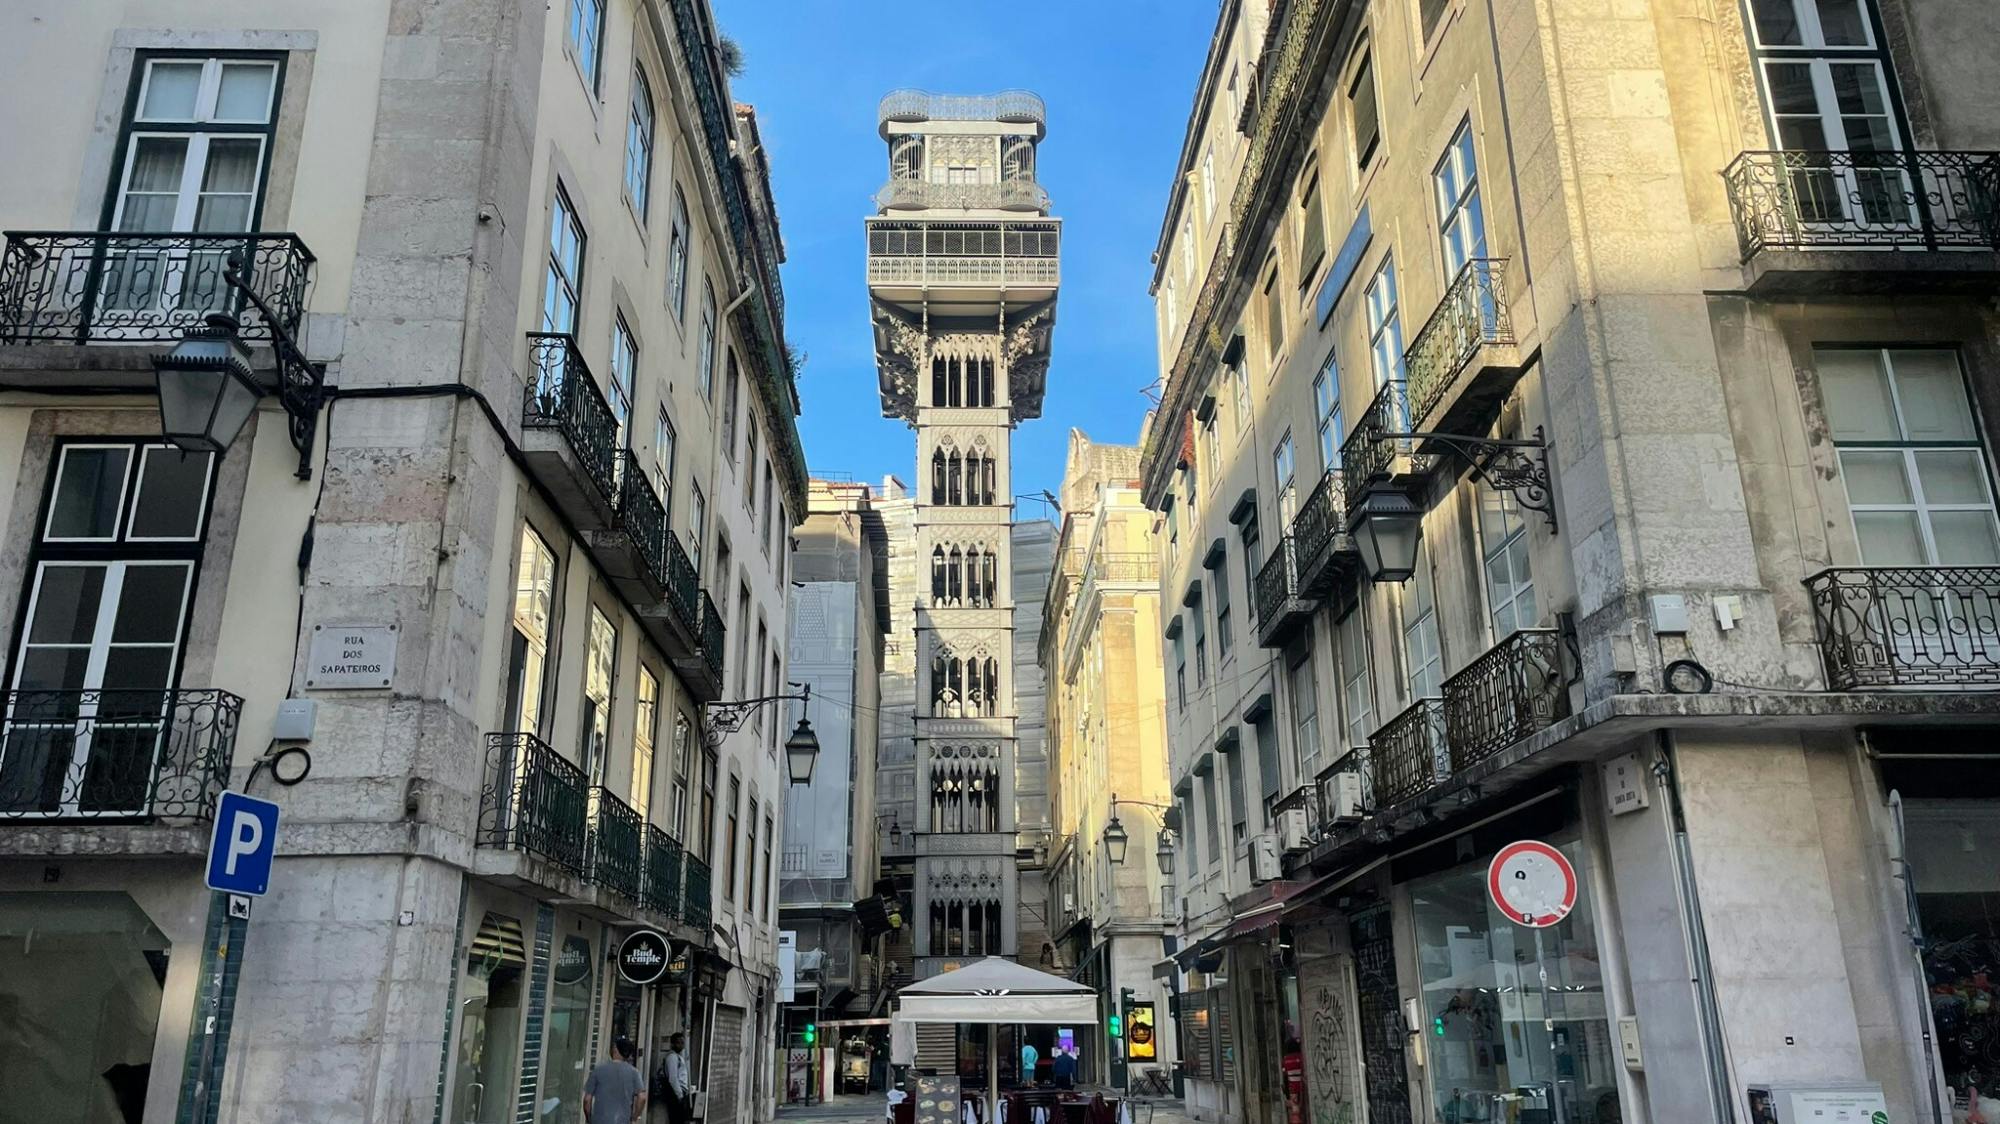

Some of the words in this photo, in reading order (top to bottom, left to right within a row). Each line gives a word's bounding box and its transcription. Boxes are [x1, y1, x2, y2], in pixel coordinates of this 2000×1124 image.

[344, 636, 365, 645] RUA
[343, 650, 363, 659] DOS
[321, 664, 381, 674] SAPATEIROS
[225, 810, 263, 875] P
[633, 948, 653, 957] Bud
[625, 954, 661, 965] Temple
